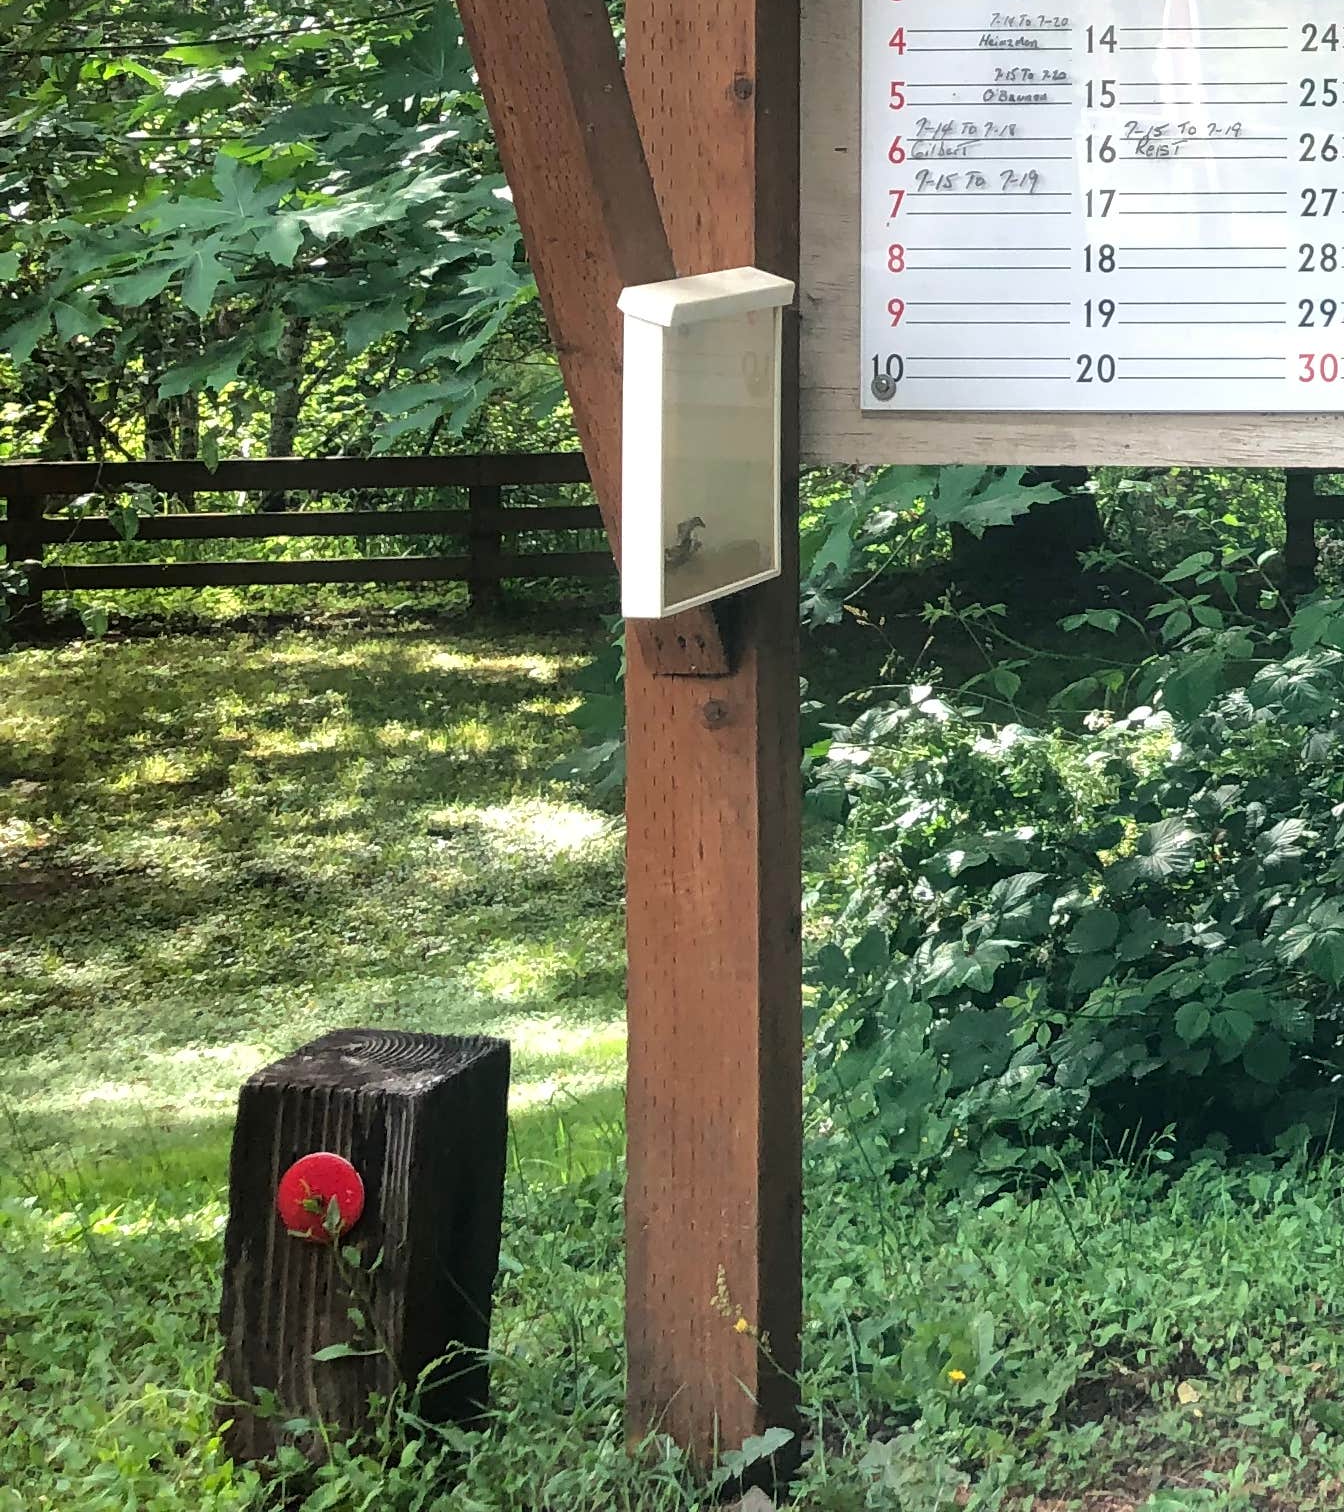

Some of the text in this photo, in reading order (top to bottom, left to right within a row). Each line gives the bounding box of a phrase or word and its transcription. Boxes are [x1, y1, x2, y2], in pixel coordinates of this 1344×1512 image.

[889, 28, 906, 55] 4
[1086, 26, 1117, 54] 14
[1302, 23, 1339, 52] 24
[889, 81, 905, 109] 5
[1085, 80, 1116, 108] 15
[1300, 79, 1338, 106] 25
